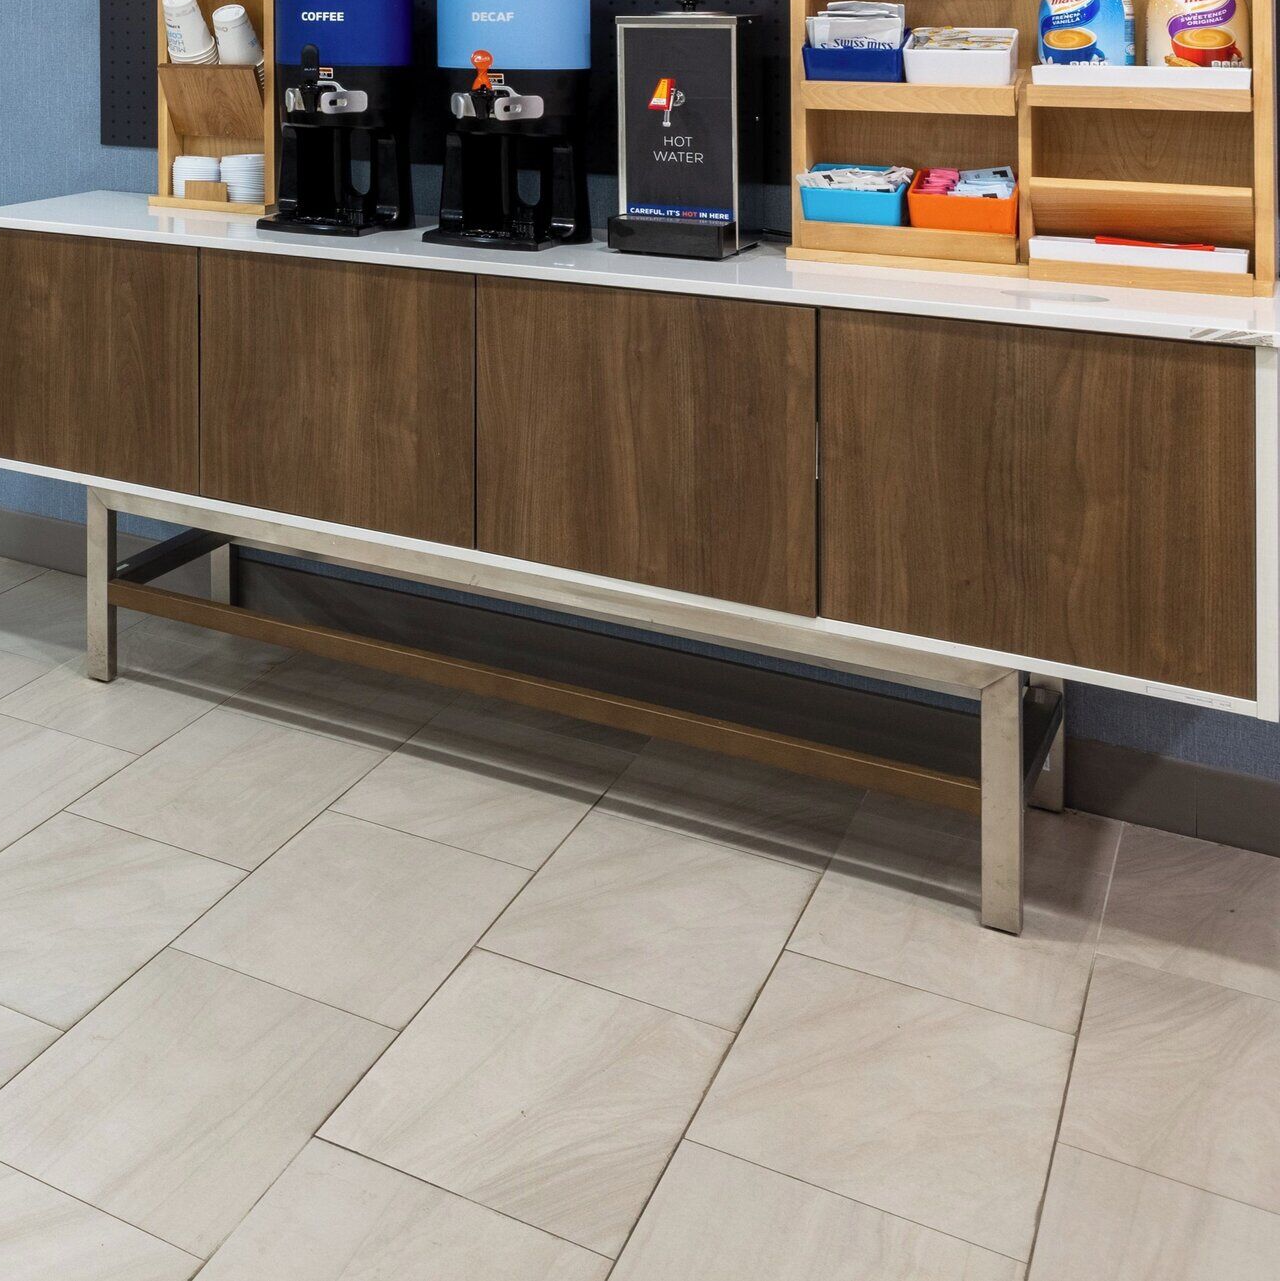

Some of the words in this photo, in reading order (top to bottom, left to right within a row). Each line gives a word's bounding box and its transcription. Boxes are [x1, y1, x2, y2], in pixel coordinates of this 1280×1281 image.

[301, 11, 345, 22] COFFEE
[471, 11, 515, 22] DECAF
[1051, 12, 1081, 22] FRENCH
[1052, 17, 1081, 26] VANILLA
[1180, 9, 1227, 23] SWEETENED
[1186, 16, 1224, 27] ORIGINAL
[663, 135, 693, 148] HOT
[653, 150, 705, 164] WATER
[629, 207, 665, 216] CAREFUL.
[666, 209, 680, 217] IT'S
[682, 210, 698, 218] HOT
[699, 211, 708, 219] IN
